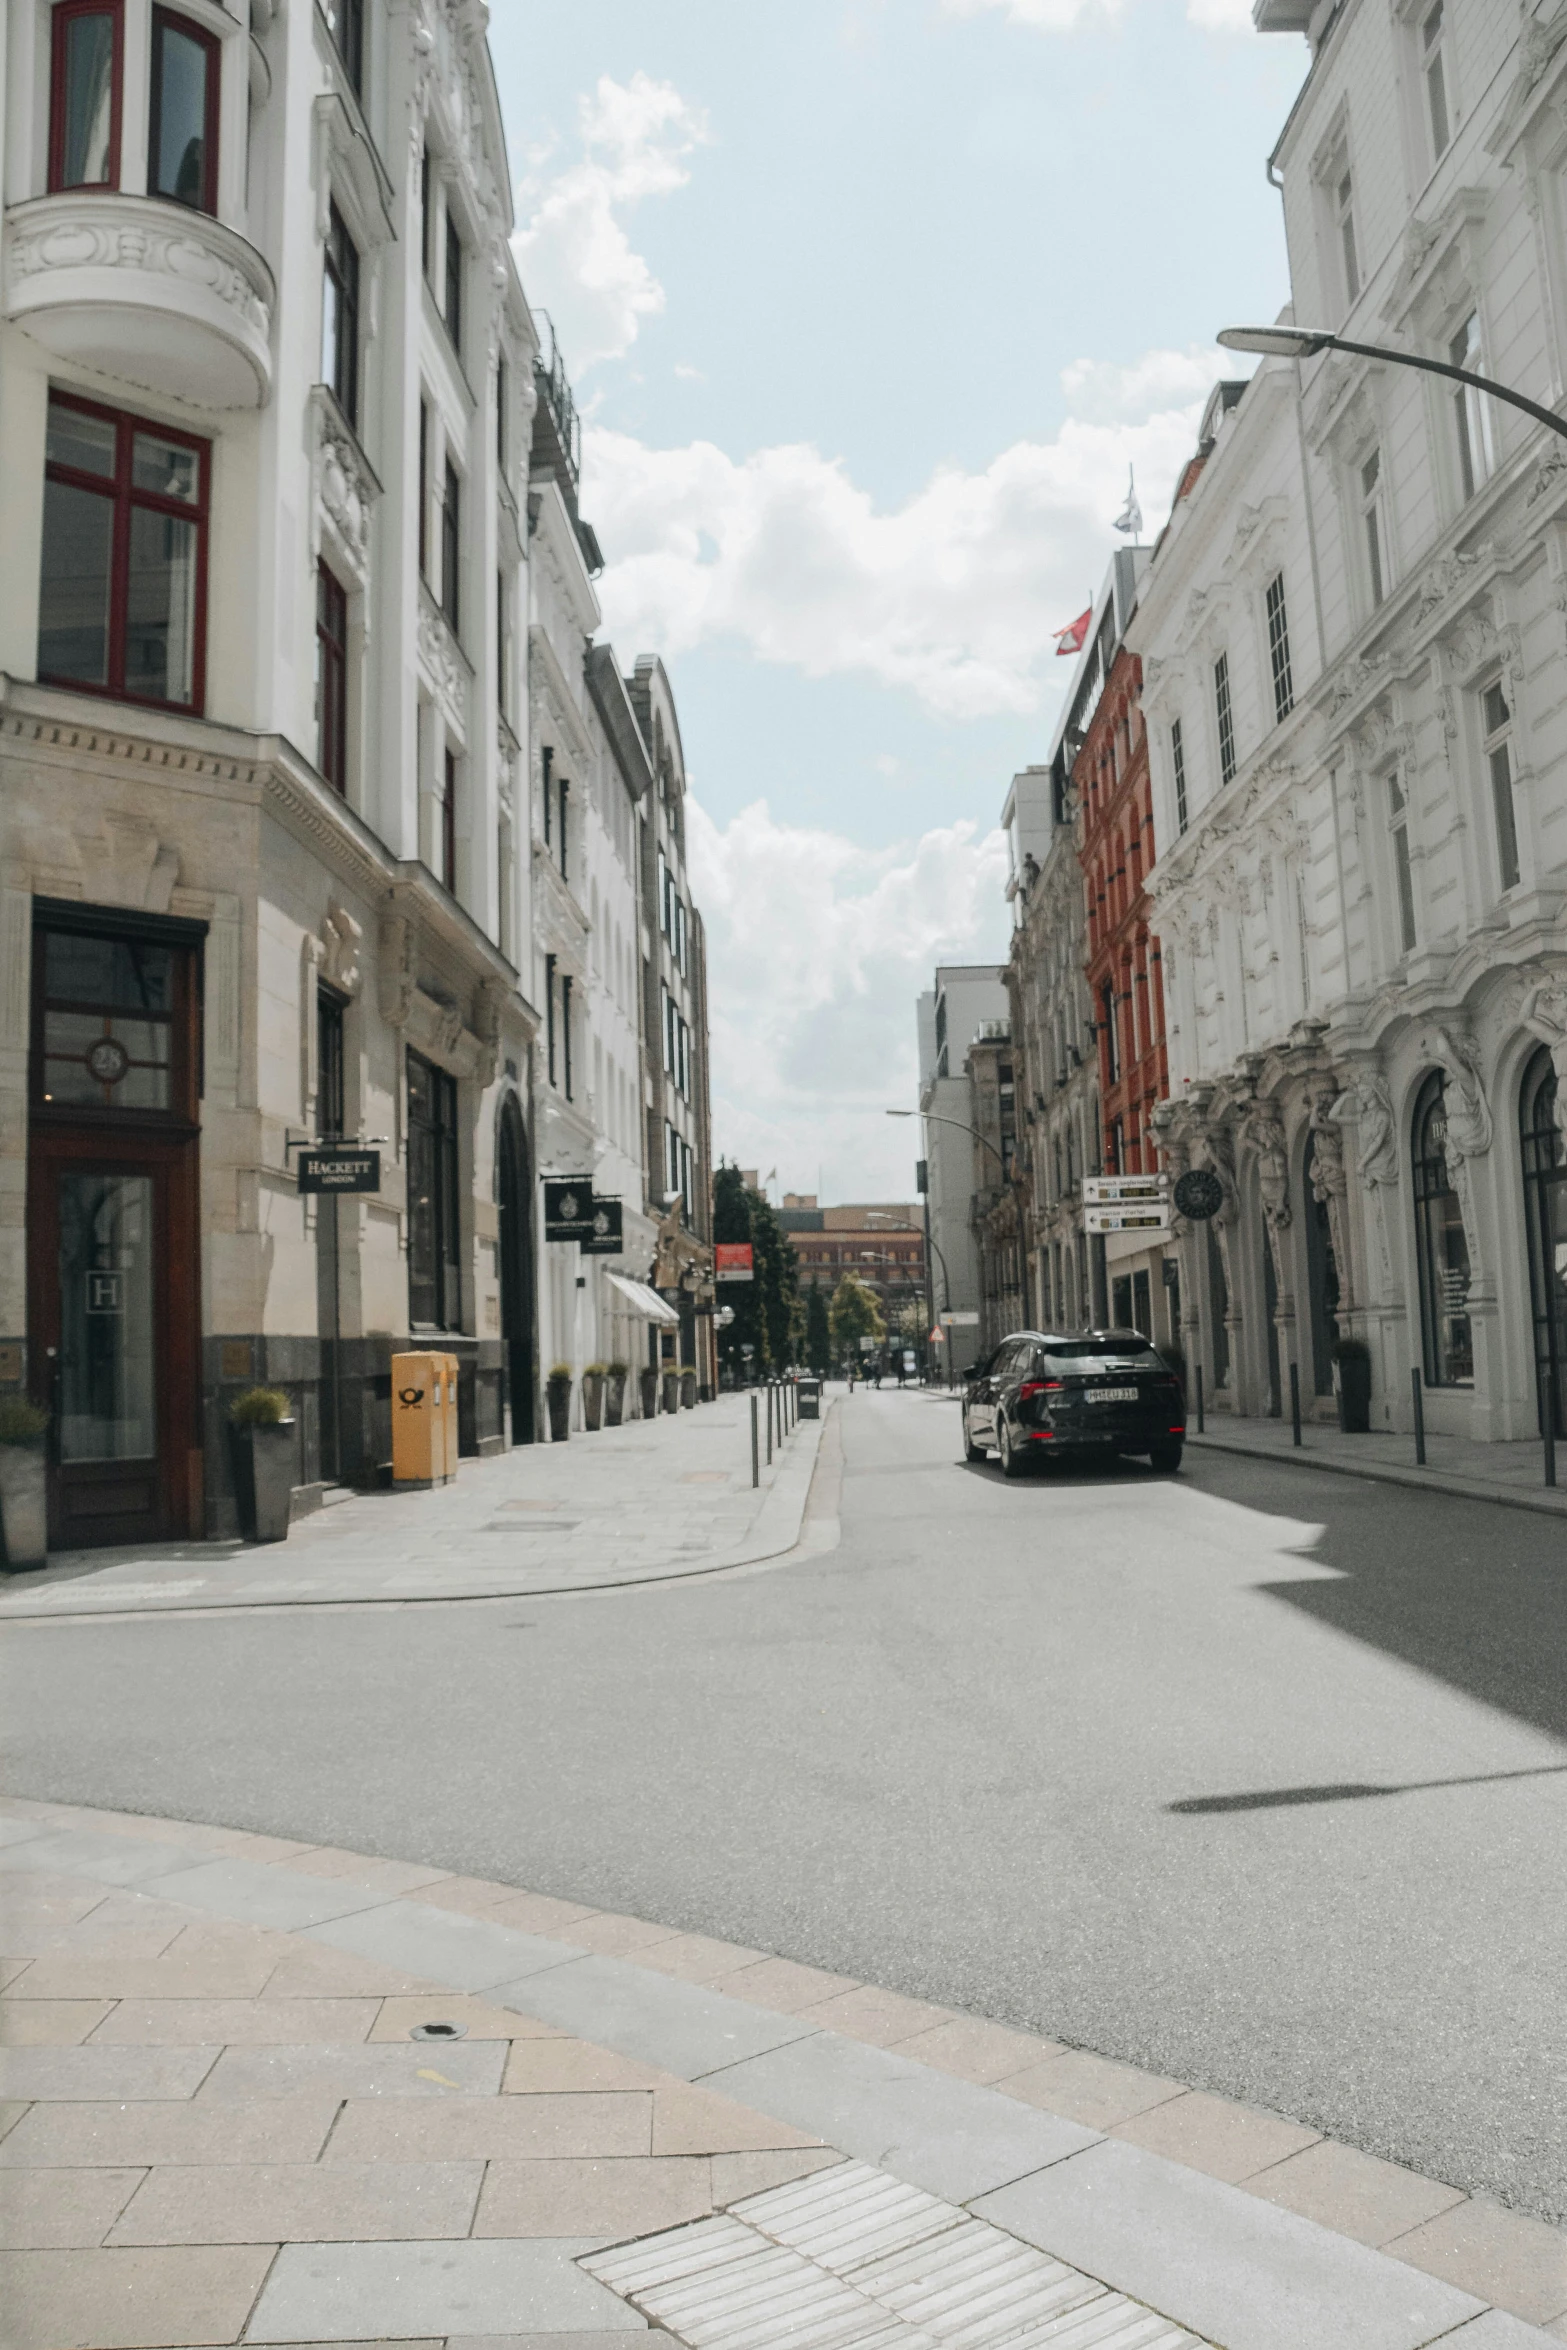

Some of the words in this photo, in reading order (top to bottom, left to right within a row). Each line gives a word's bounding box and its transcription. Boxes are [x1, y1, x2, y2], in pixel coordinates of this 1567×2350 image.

[308, 1160, 371, 1174] HACKETT
[322, 1175, 356, 1184] LONDON
[95, 1279, 117, 1306] H
